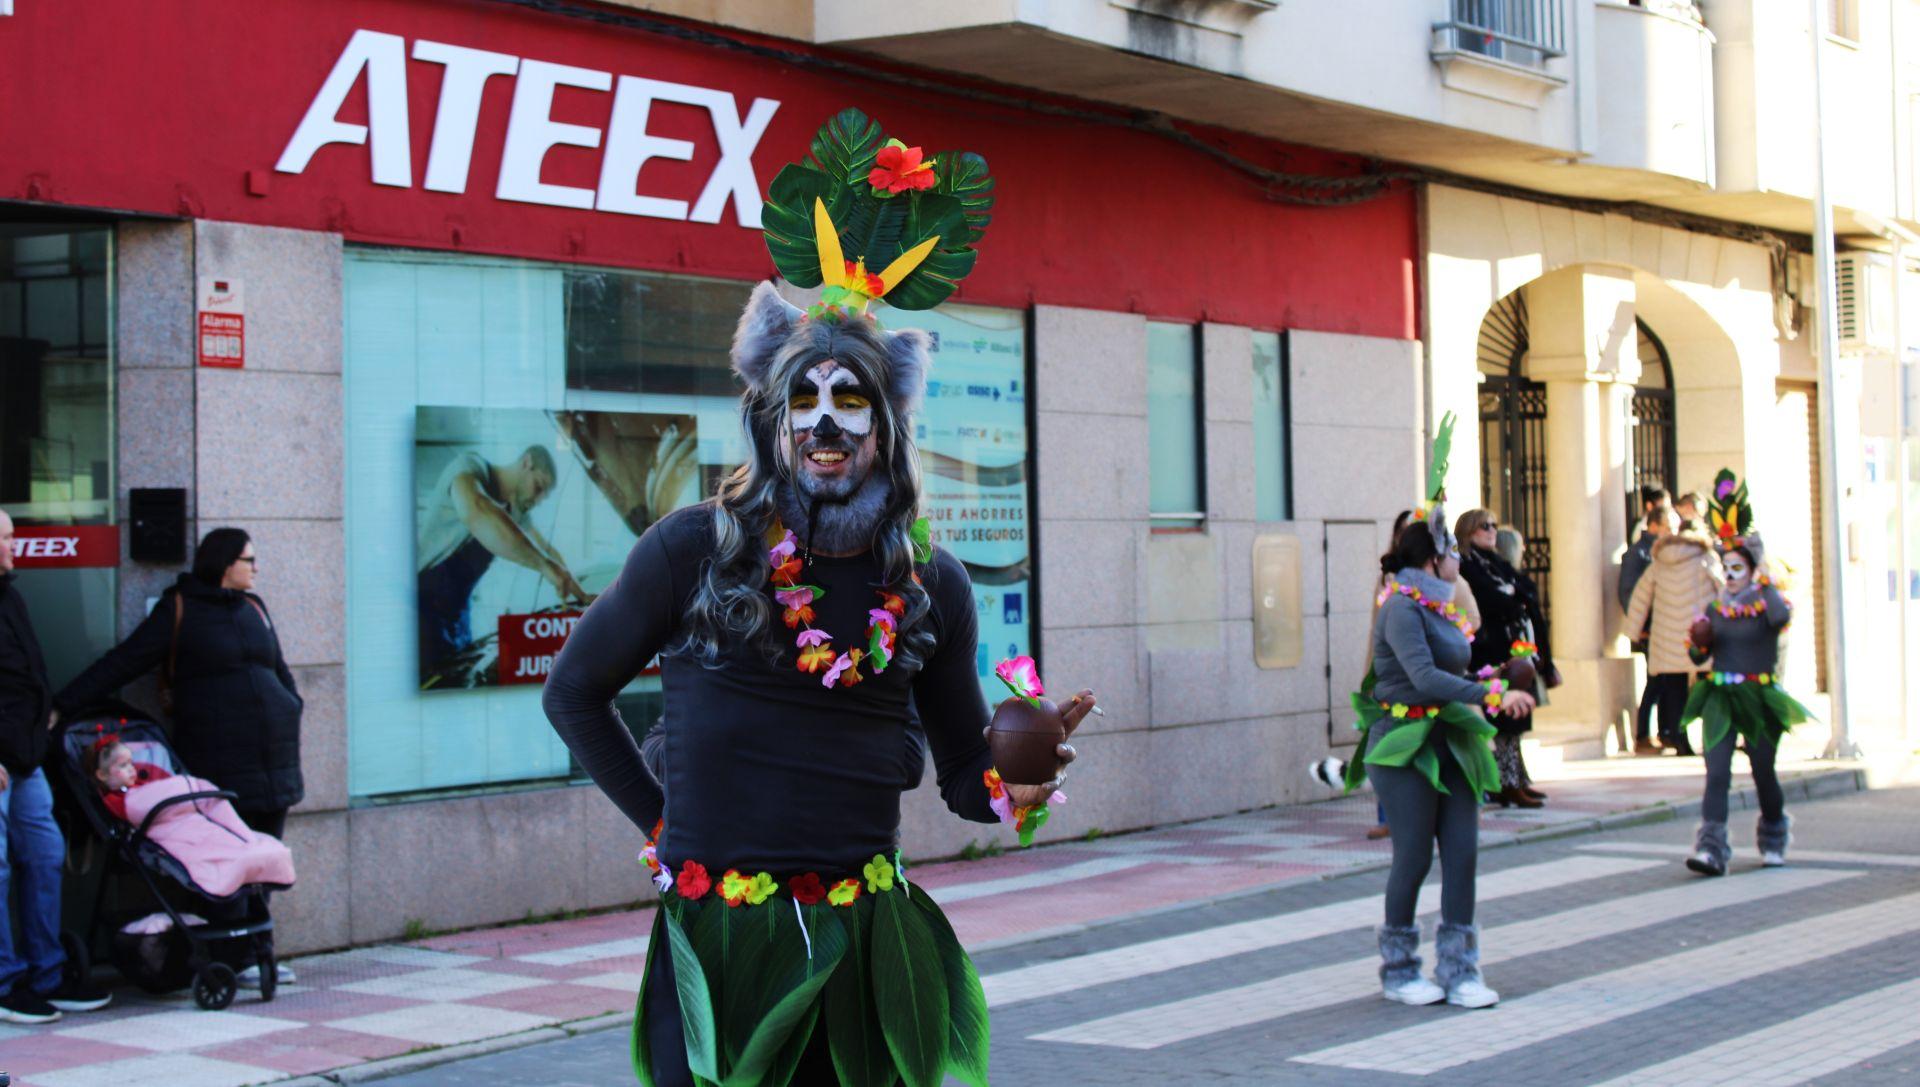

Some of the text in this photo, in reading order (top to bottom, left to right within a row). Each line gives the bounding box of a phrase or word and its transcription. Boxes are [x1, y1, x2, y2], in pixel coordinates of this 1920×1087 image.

[275, 29, 781, 229] ATEEX
[960, 507, 1023, 521] AHORRES
[946, 528, 967, 542] TUS
[972, 528, 1024, 542] SEGUROS
